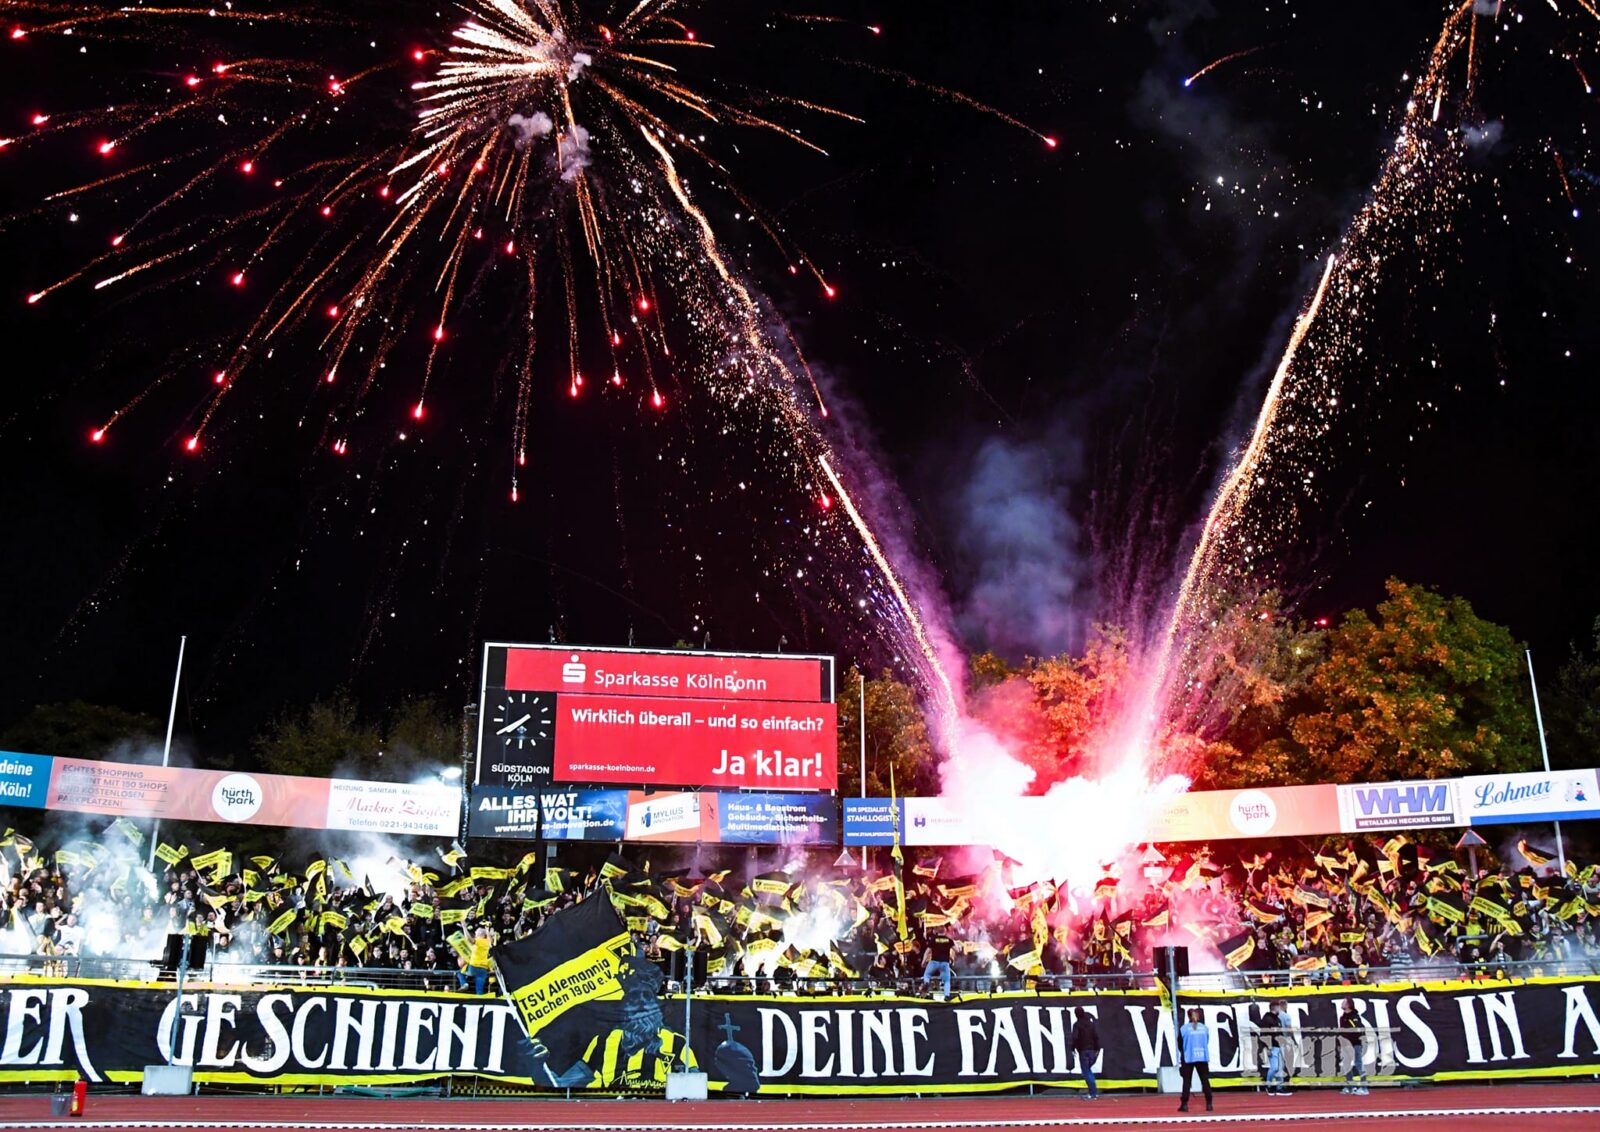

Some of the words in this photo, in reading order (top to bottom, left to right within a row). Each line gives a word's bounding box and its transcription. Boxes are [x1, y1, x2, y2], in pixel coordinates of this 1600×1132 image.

[594, 670, 679, 688] Sparkasse
[686, 672, 767, 691] KölnBonn
[571, 708, 635, 725] Wirklich
[638, 709, 692, 727] überall
[708, 715, 737, 728] und
[740, 718, 758, 729] so
[762, 714, 824, 731] einfach?
[491, 763, 550, 775] SÜDSTADION
[568, 763, 656, 773] sparkasse-koelnbonn.de
[712, 749, 746, 776] Ja
[755, 750, 823, 777] klar!
[98, 768, 144, 778] SHOPPING
[507, 772, 533, 783] KÖLN
[0, 781, 32, 798] Köln!
[1473, 780, 1552, 809] Lohmar
[478, 795, 535, 811] ALLES
[540, 793, 578, 807] WAT
[727, 803, 753, 812] Haus-
[1355, 785, 1448, 815] WHM
[507, 809, 538, 824] IHR
[543, 806, 592, 822] VOLT!
[653, 807, 684, 819] MYLIUS
[1358, 817, 1398, 827] METALLBAU
[1398, 816, 1431, 826] HECKNER
[518, 987, 546, 1011] TSV
[547, 957, 611, 997] Alemannia
[527, 994, 571, 1023] Aachen
[569, 981, 597, 998] 1900
[0, 988, 104, 1082] ER
[756, 1008, 936, 1078] DEINE
[1453, 990, 1531, 1063] IN
